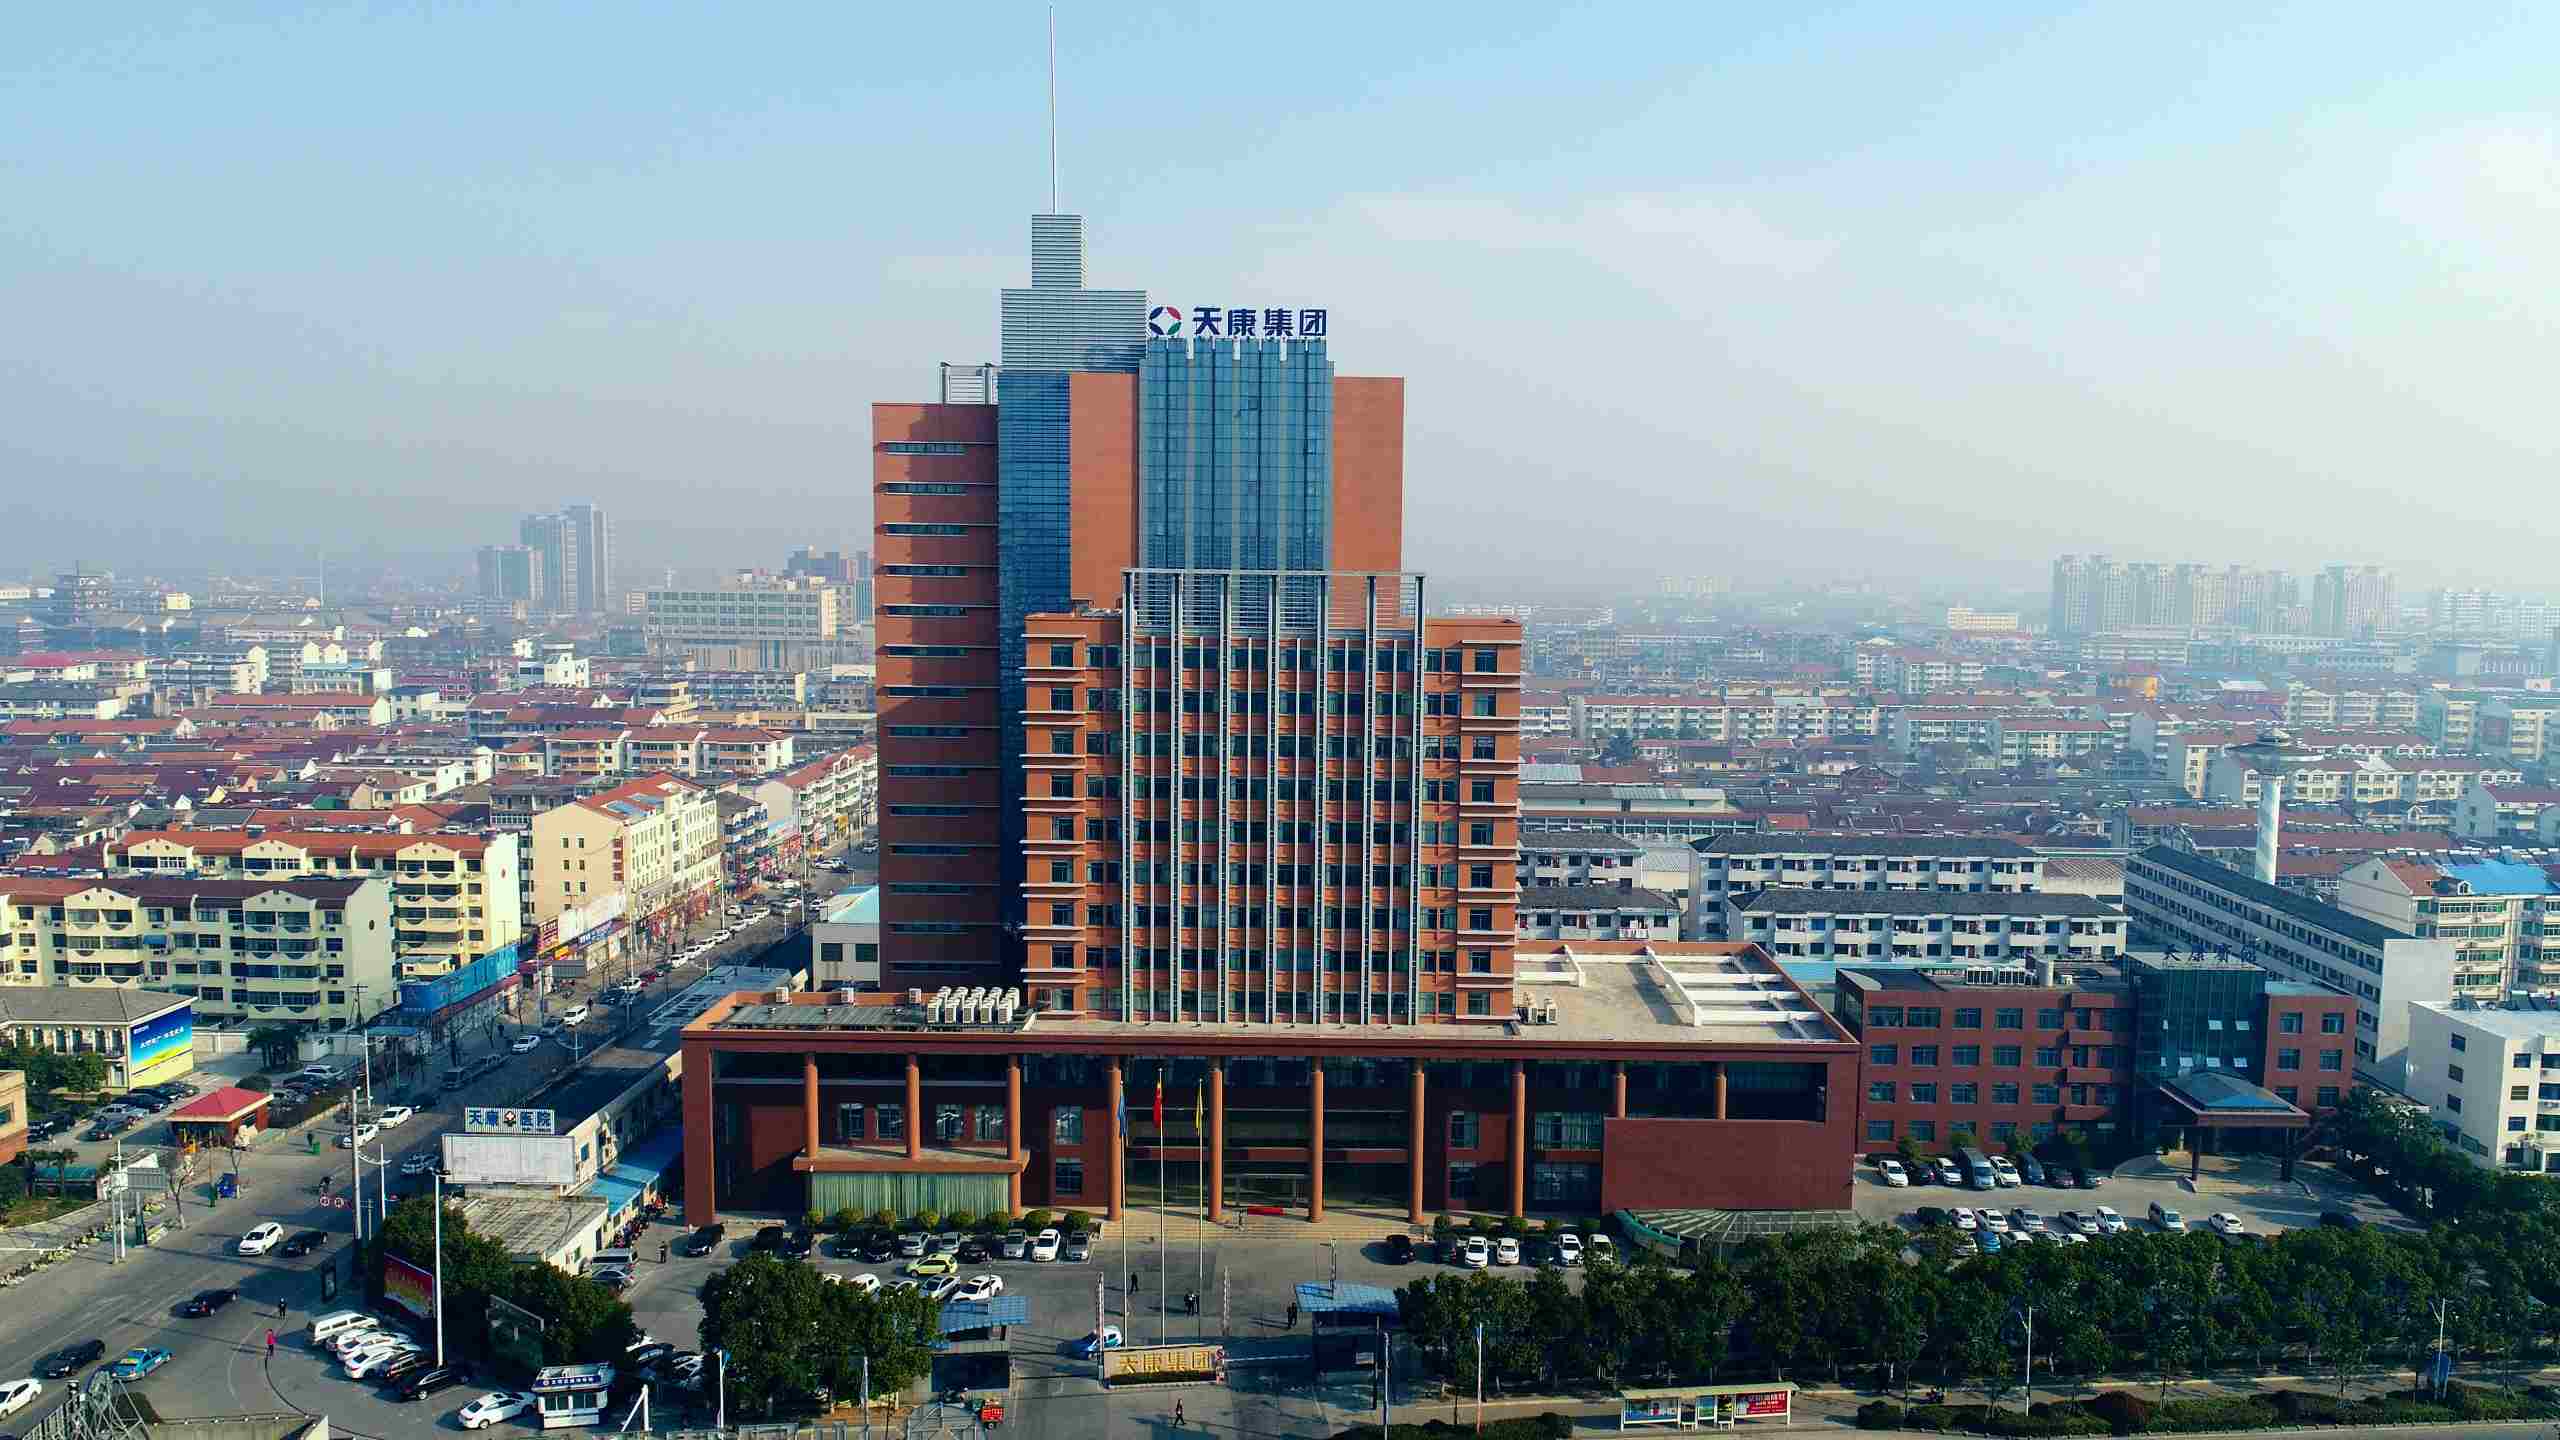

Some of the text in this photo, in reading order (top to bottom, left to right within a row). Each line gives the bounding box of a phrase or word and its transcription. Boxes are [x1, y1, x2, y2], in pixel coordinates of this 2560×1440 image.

[1193, 307, 1327, 337] 天康集团
[1119, 1350, 1210, 1375] 天康集团
